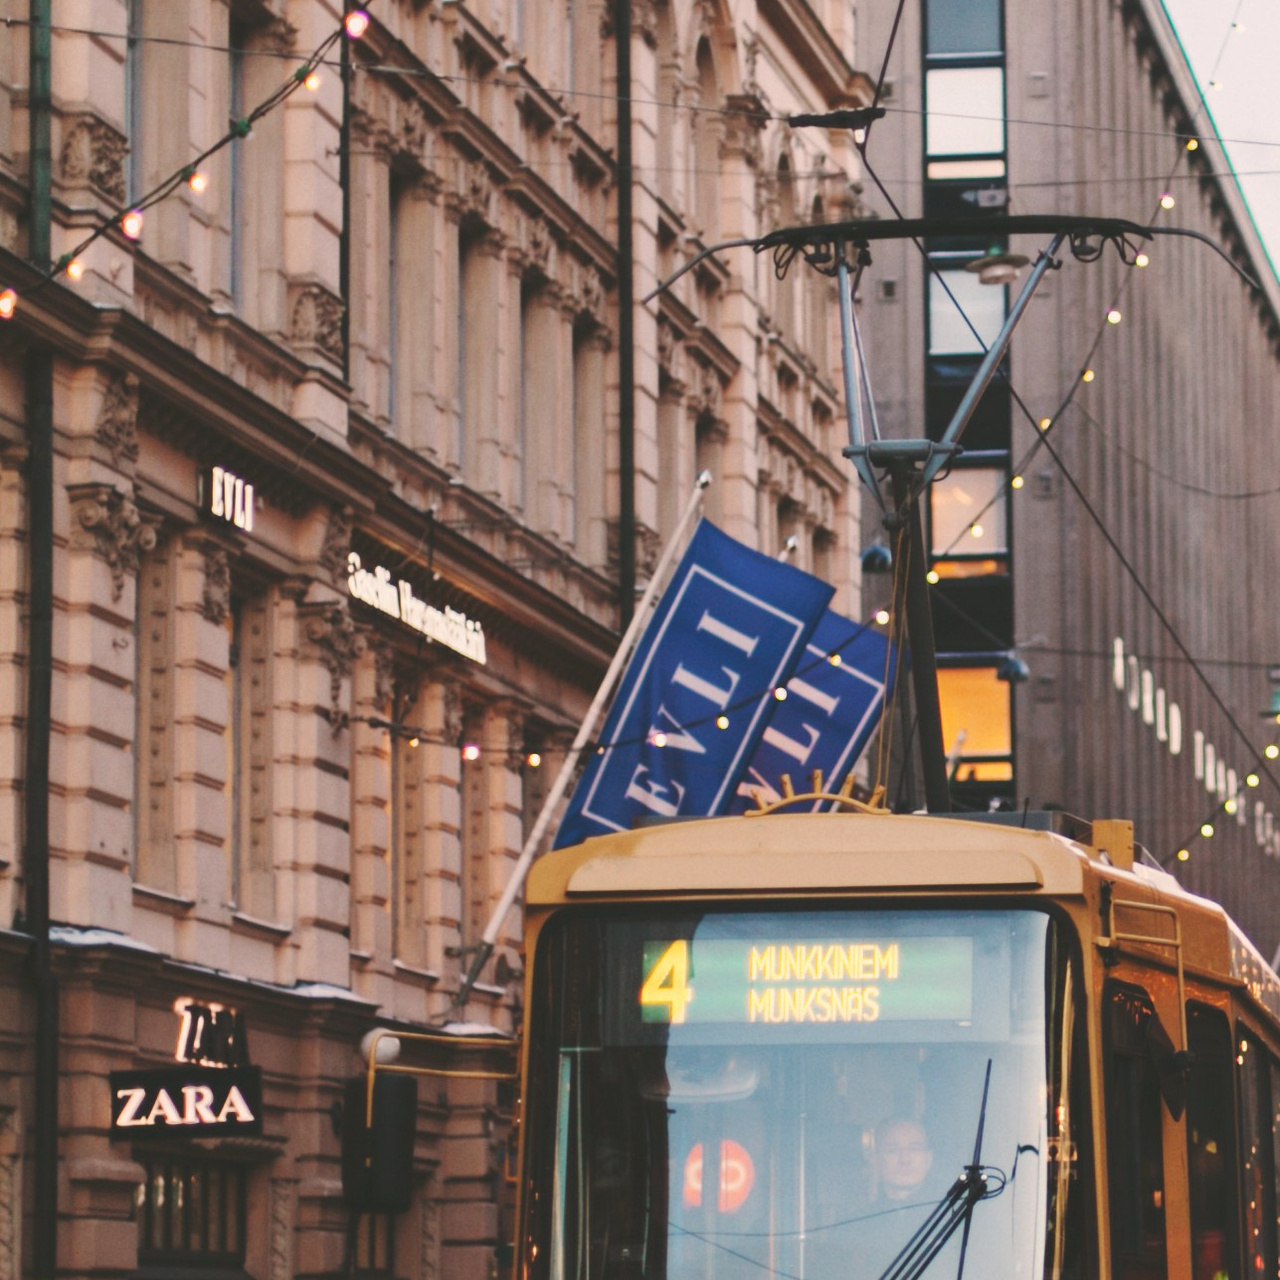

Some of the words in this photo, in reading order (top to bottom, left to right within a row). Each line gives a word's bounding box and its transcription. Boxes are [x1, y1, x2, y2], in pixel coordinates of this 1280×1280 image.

[211, 466, 254, 532] EVLI
[625, 609, 760, 818] EVLI
[737, 677, 840, 804] VLI
[639, 938, 694, 1025] 4
[750, 944, 899, 981] MUNKKINIEMI
[750, 986, 880, 1024] MUNKSNÄS
[116, 1085, 255, 1127] ZARA
